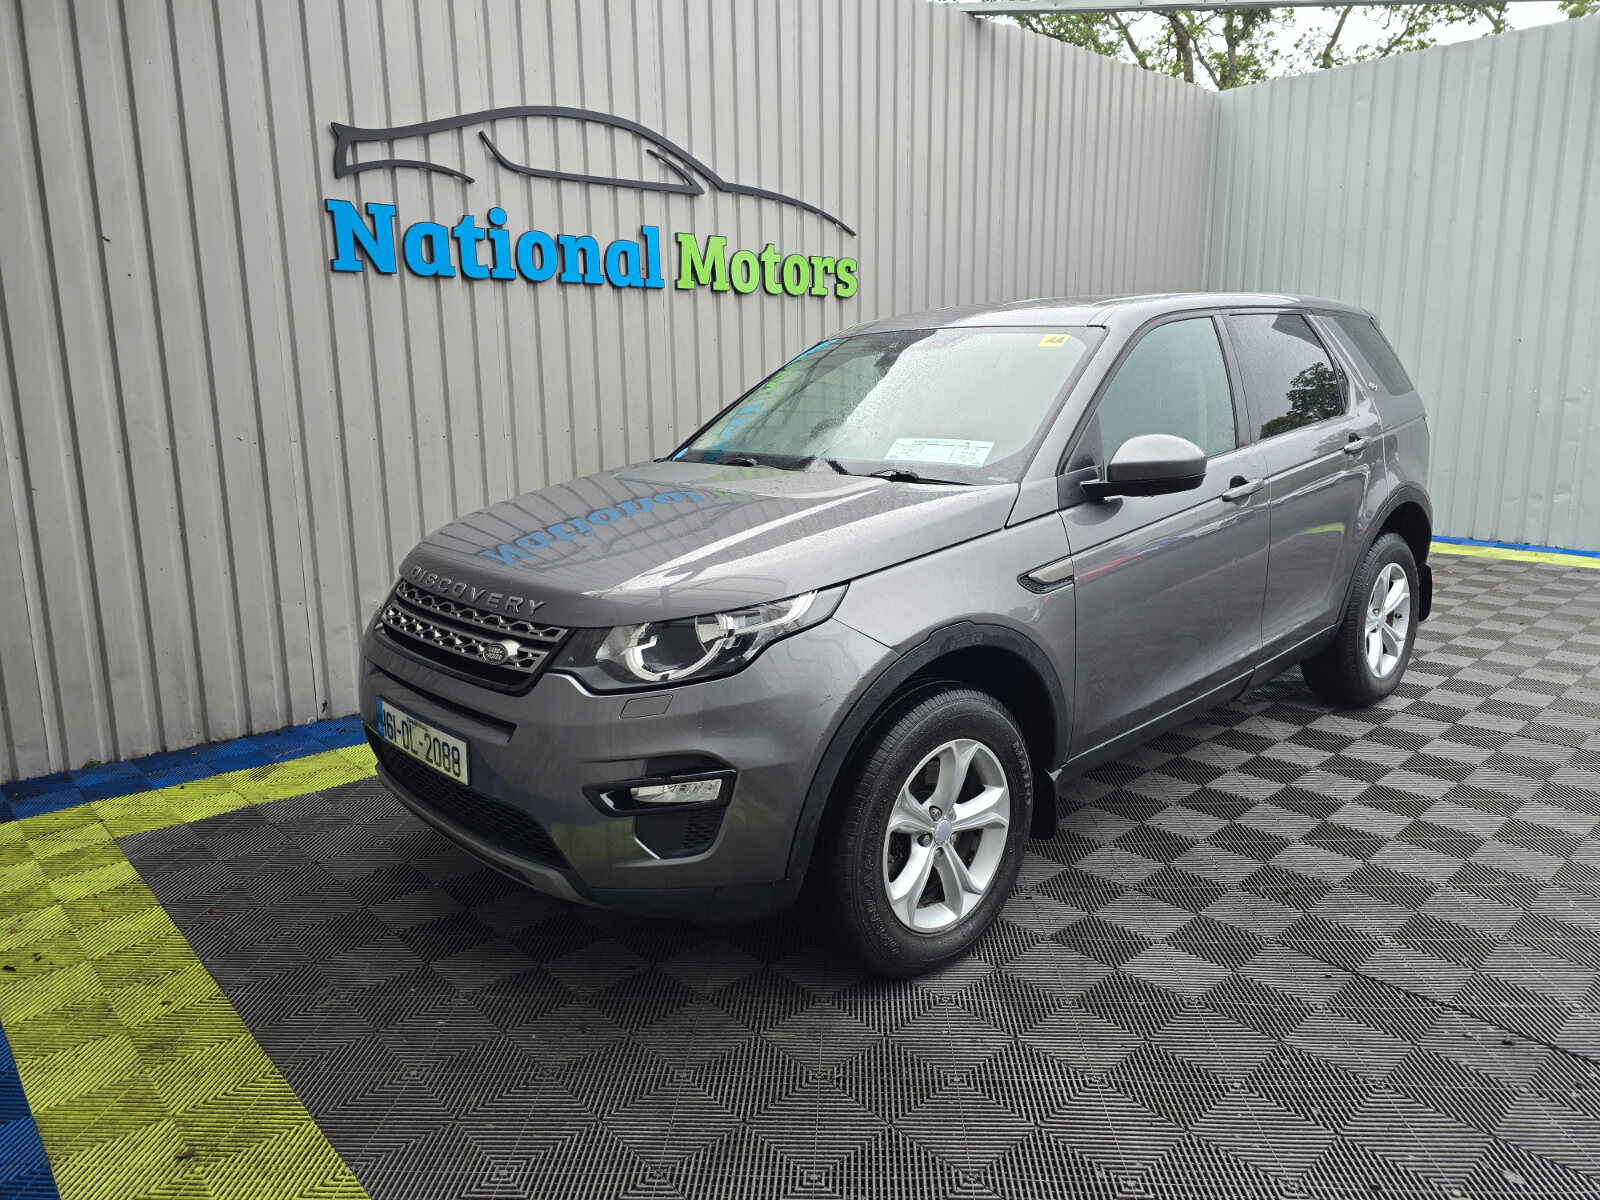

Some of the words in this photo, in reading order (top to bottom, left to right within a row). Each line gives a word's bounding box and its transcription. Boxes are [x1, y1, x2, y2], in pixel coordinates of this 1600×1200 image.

[325, 198, 664, 289] National
[676, 231, 859, 298] Motors
[410, 565, 546, 616] DISCOVERY
[383, 708, 462, 778] 161-DL-2088
